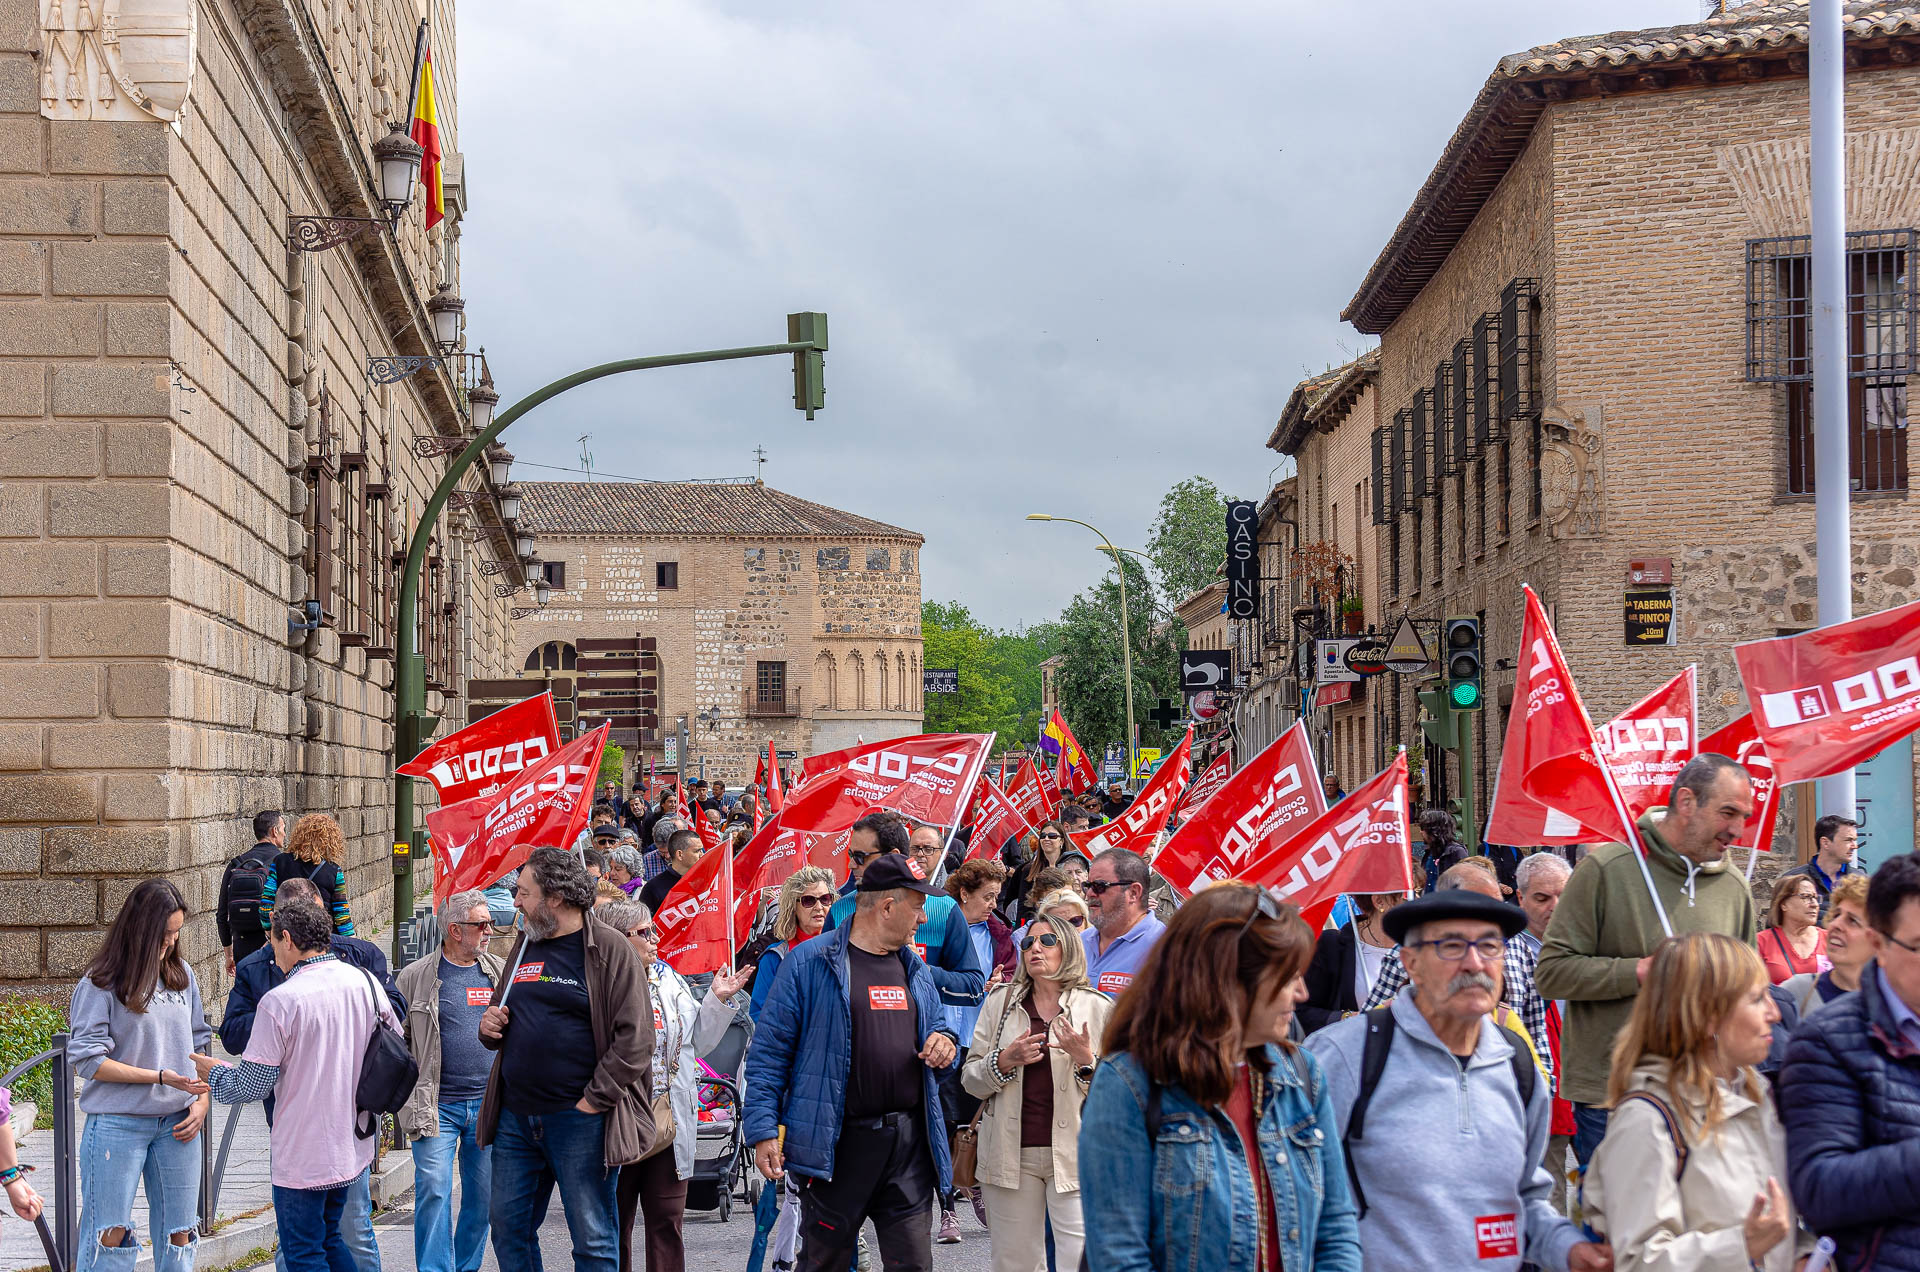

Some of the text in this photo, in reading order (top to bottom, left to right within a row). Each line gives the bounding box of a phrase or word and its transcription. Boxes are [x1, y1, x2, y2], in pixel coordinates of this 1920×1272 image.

[1232, 504, 1255, 617] CASINO
[1633, 600, 1673, 610] TABERNA
[1639, 613, 1671, 624] PINTOR
[1393, 645, 1420, 654] DELTA
[923, 684, 957, 693] ABSIDE
[1100, 974, 1133, 985] CCOO
[468, 990, 493, 999] CCO
[871, 990, 905, 1000] CCOO
[1477, 1220, 1515, 1241] CCOO
